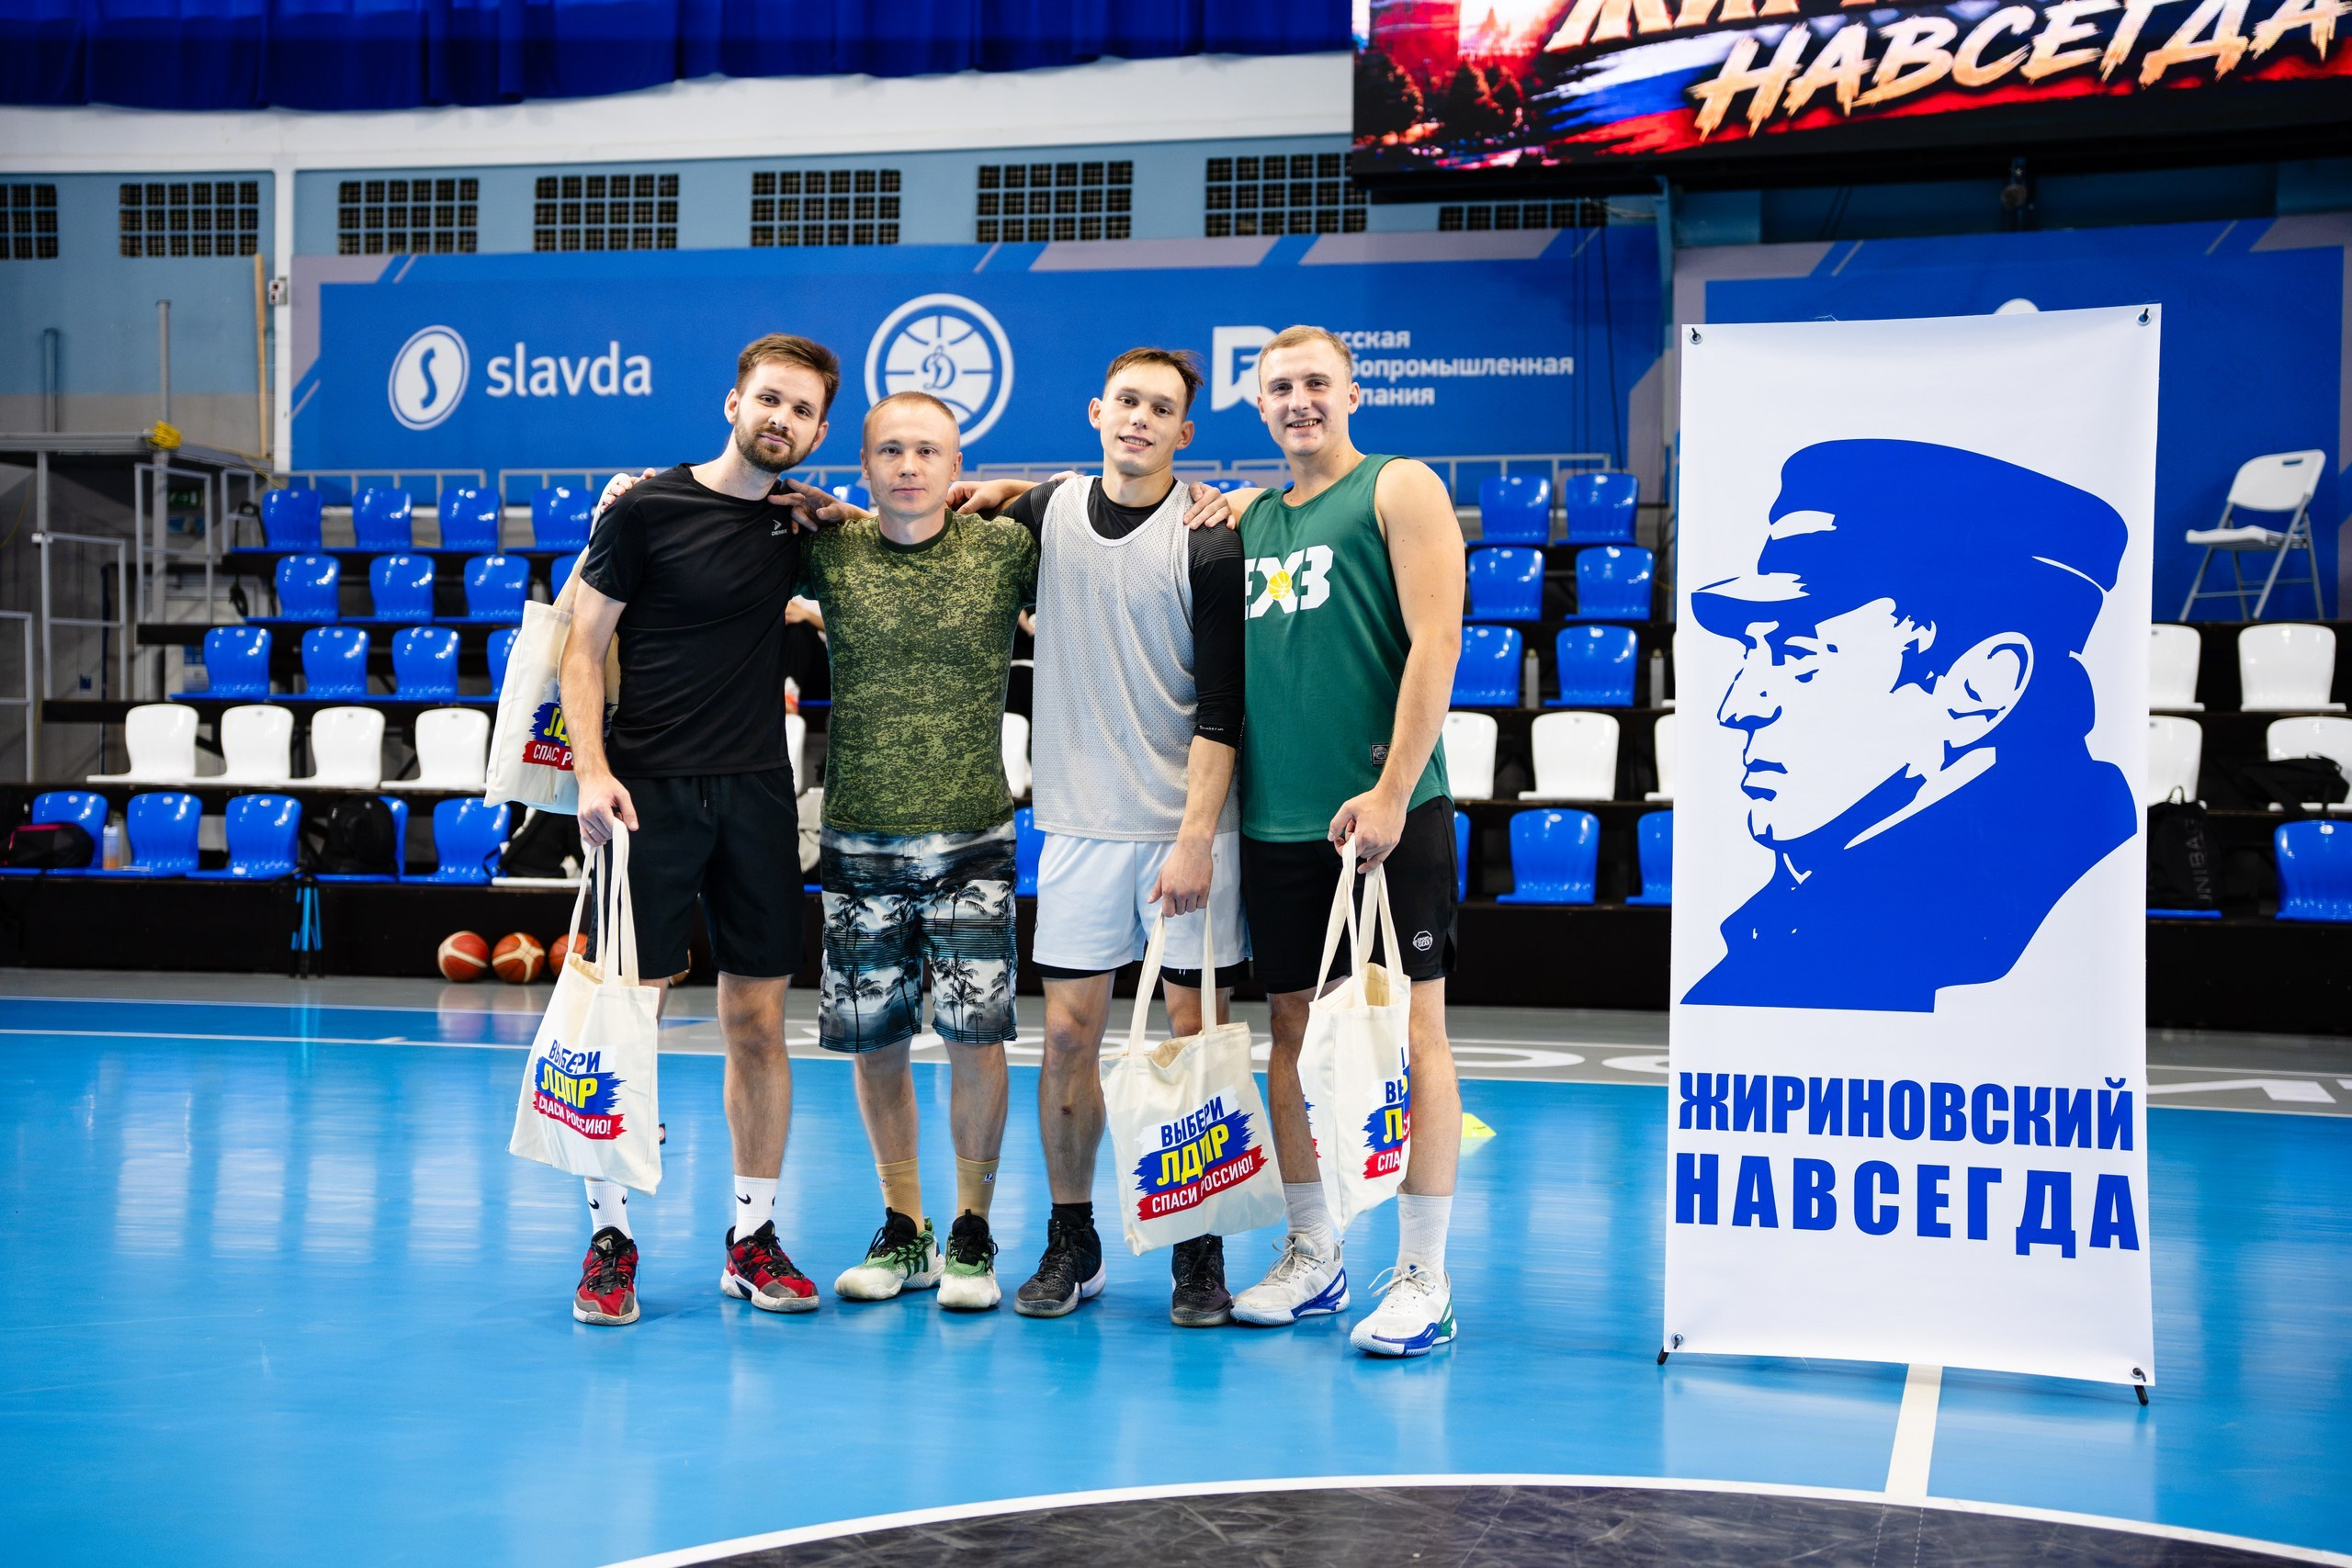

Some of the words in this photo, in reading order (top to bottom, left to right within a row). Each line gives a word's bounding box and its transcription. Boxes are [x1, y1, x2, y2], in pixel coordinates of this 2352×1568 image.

[1687, 0, 2352, 142] НАВСЕГДА
[1335, 330, 1411, 349] сская
[486, 341, 652, 397] slavda
[533, 743, 560, 762] СПАС
[548, 1039, 601, 1074] ВЫБЕРИ
[540, 1063, 598, 1109] ЛДПР
[1679, 1071, 2134, 1152] ЖИРИНОВСКИЙ
[538, 1095, 565, 1120] СПАСИ
[566, 1110, 611, 1135] РОССИЮ!
[1160, 1096, 1225, 1147] ВЫБЕРИ
[1156, 1123, 1229, 1186] ЛДПР
[1152, 1186, 1198, 1213] СПАСИ
[1200, 1155, 1254, 1197] РОССИЮ!
[1675, 1152, 2140, 1259] НАВСЕГДА
